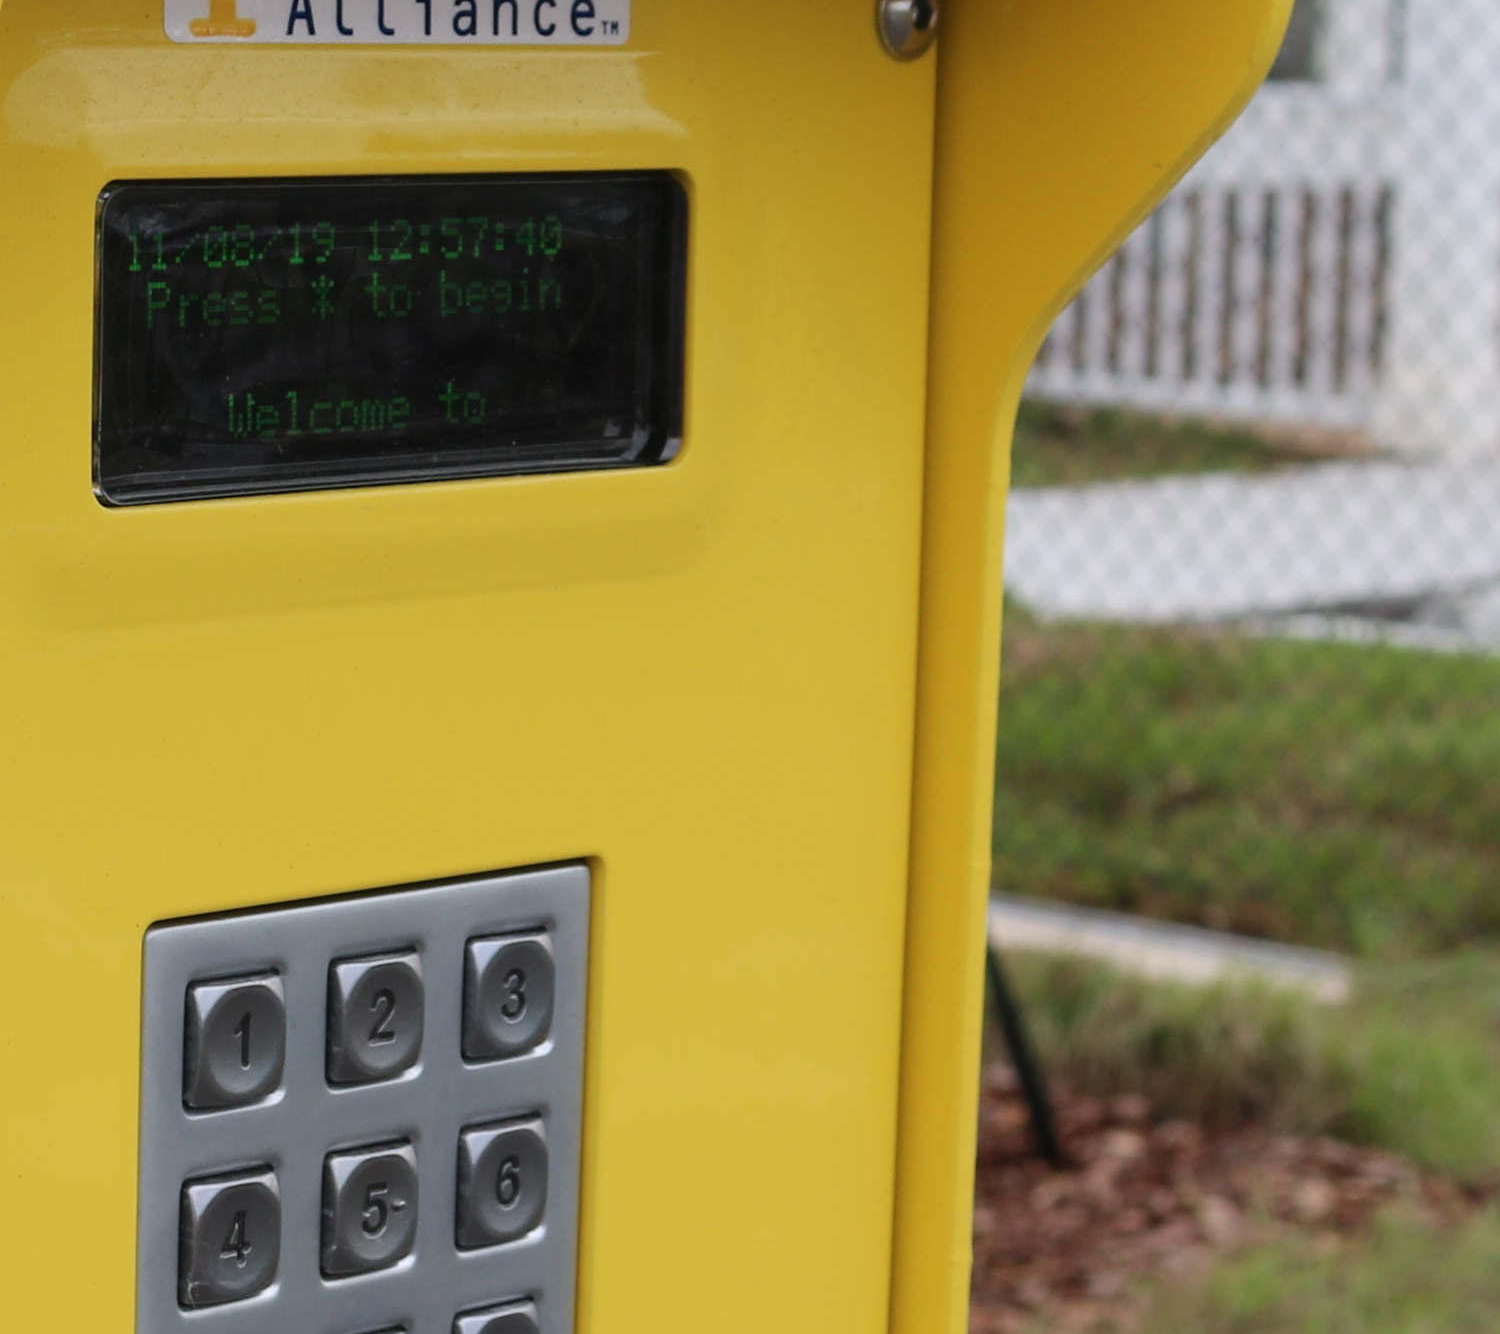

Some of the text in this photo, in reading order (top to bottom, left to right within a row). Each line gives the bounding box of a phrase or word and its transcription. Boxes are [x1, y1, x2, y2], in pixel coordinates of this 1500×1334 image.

[127, 214, 565, 272] 11/08/19 12:57:40
[145, 279, 282, 329] Press
[363, 270, 415, 318] to
[438, 265, 565, 317] begin
[227, 379, 488, 439] Welcome to
[232, 967, 527, 1071] 1 2 3
[219, 1154, 521, 1269] 4 5 6
